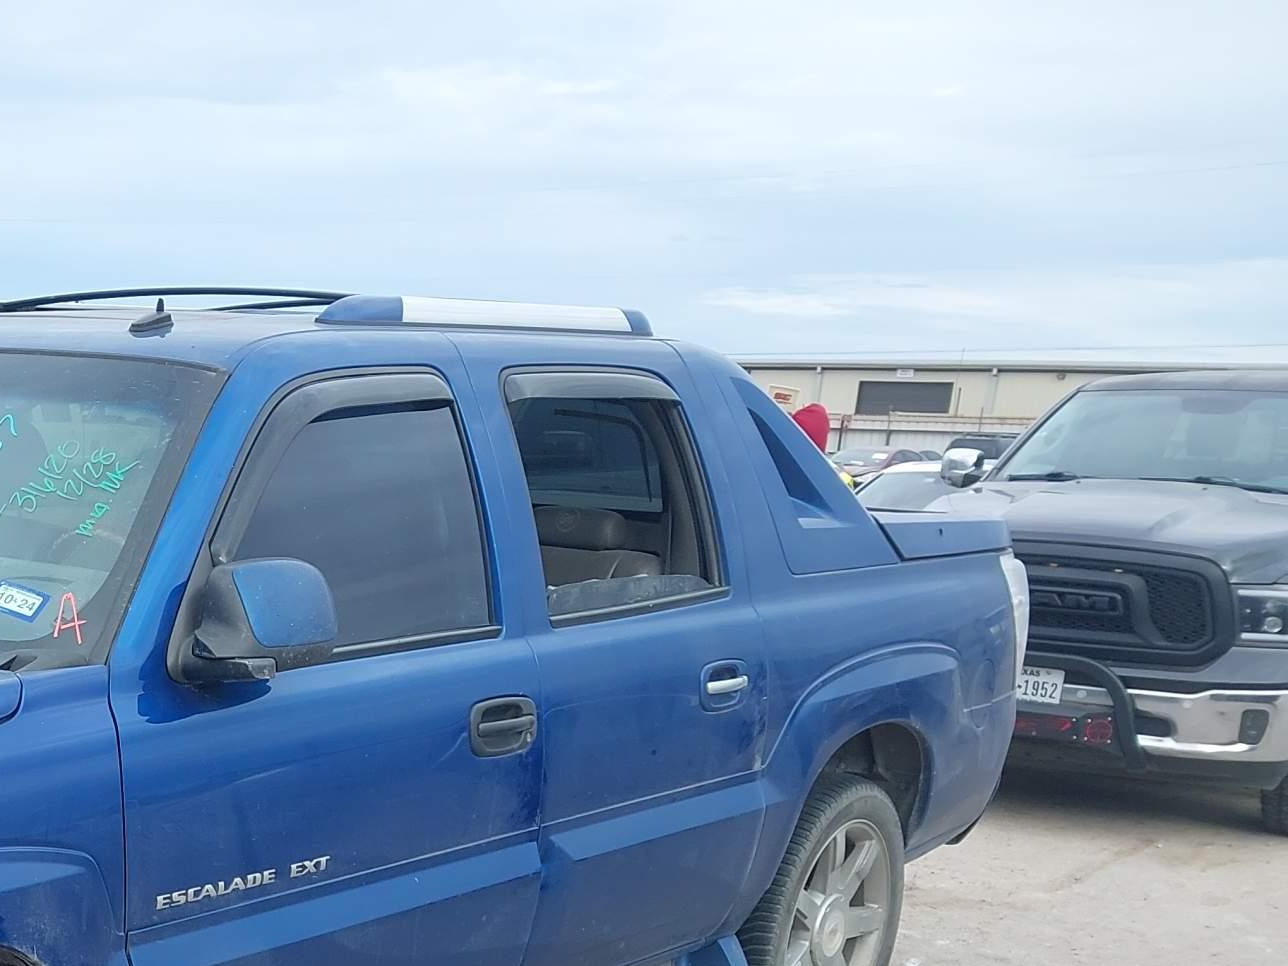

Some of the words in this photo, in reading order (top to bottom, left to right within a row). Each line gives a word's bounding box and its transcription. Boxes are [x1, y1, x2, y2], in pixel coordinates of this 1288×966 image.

[52, 592, 88, 645] A
[155, 868, 277, 911] ESCALADE
[289, 855, 332, 879] EXT
